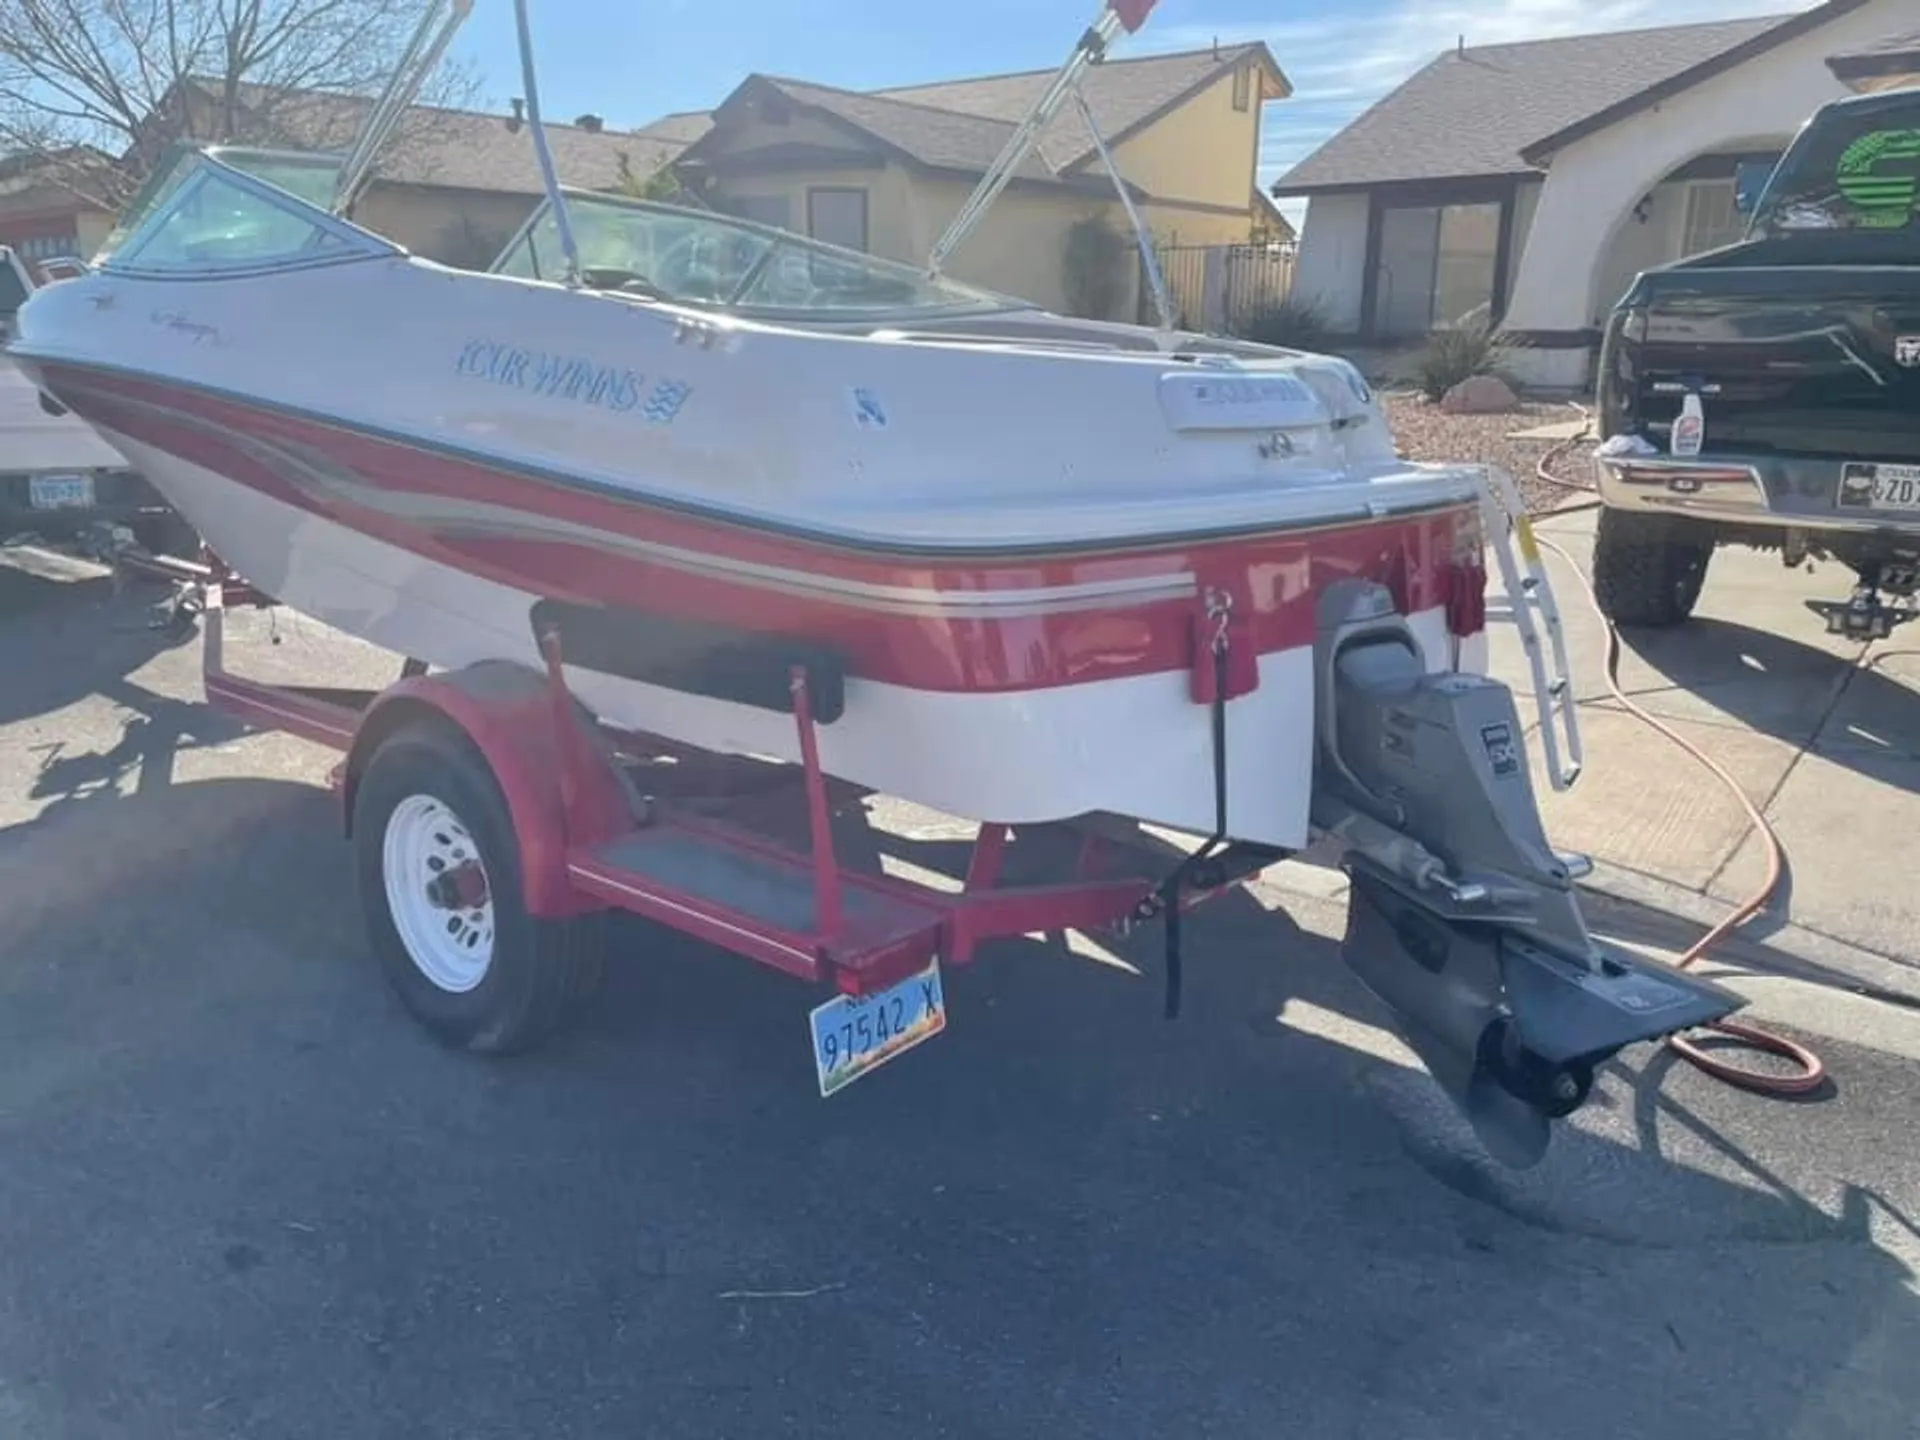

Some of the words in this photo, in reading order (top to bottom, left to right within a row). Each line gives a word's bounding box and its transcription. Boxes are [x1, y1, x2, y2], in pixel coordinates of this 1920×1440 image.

[1885, 478, 1920, 503] ZD
[823, 997, 905, 1073] 97542
[920, 981, 937, 1018] X
